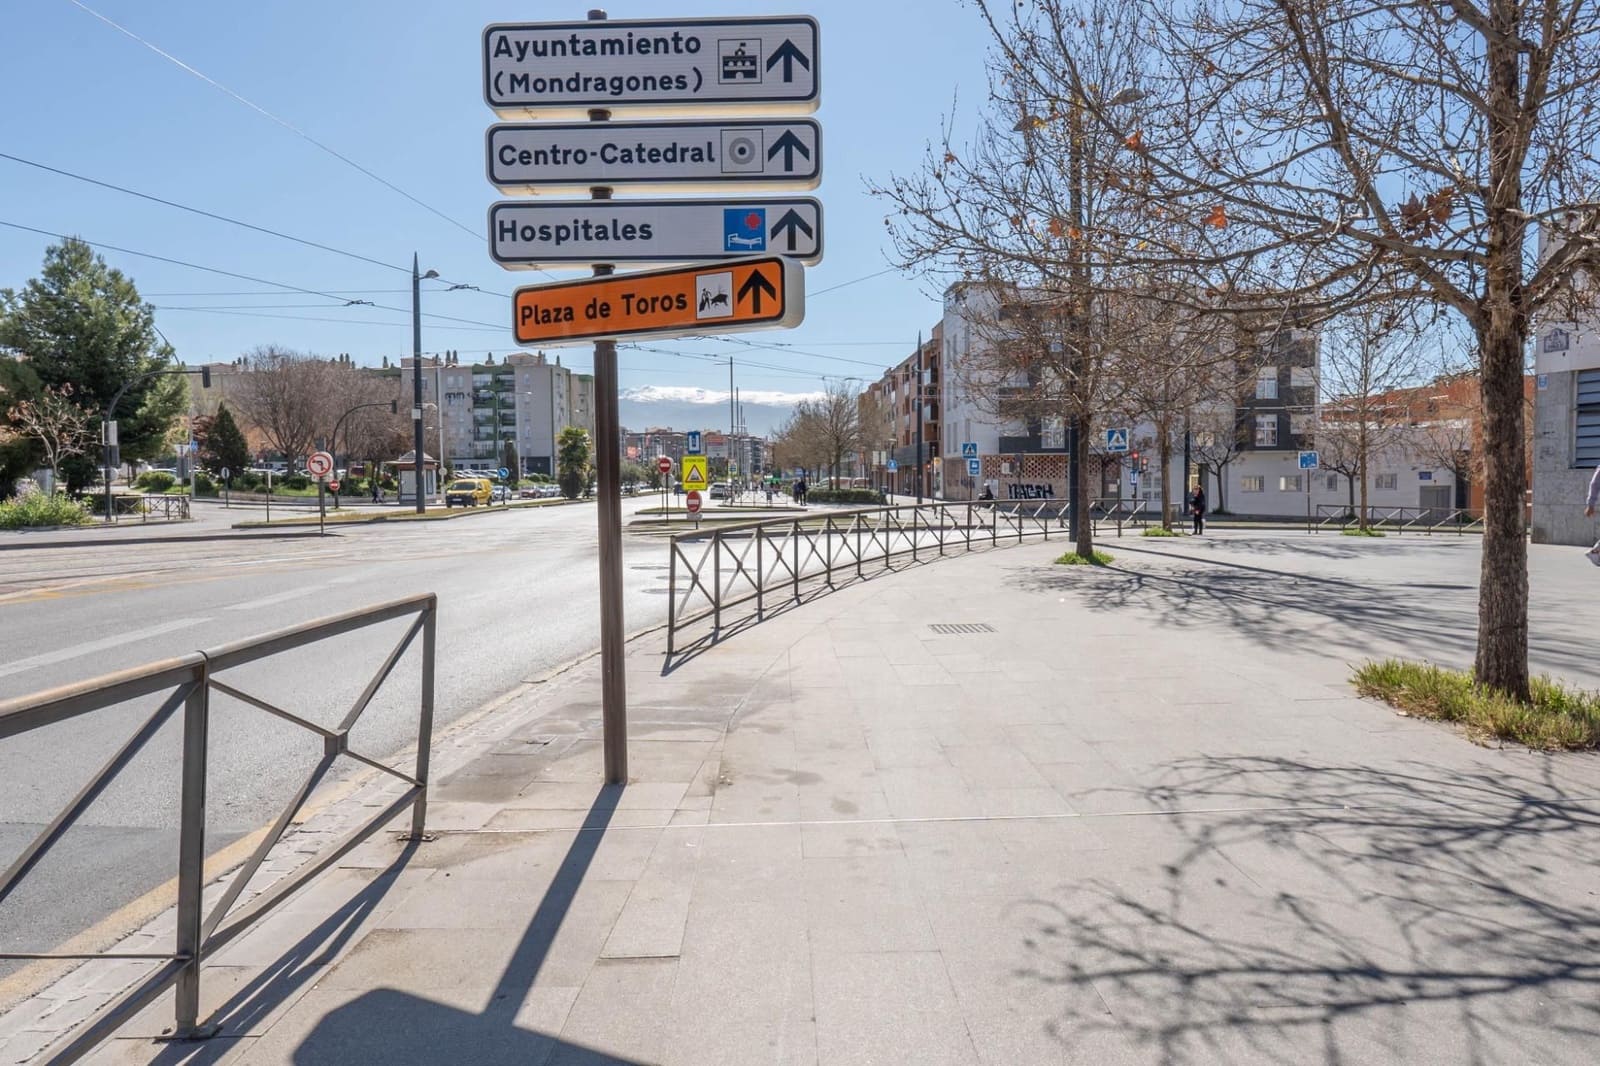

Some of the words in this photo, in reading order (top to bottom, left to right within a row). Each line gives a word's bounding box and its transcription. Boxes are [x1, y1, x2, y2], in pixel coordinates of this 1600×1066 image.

[493, 31, 702, 63] Ayuntamiento
[493, 67, 704, 97] (Mondragones)
[498, 140, 716, 167] Centro-Catedral
[498, 218, 654, 247] Hospitales
[521, 304, 575, 327] Plaza
[584, 296, 612, 321] de
[620, 292, 688, 317] Toros
